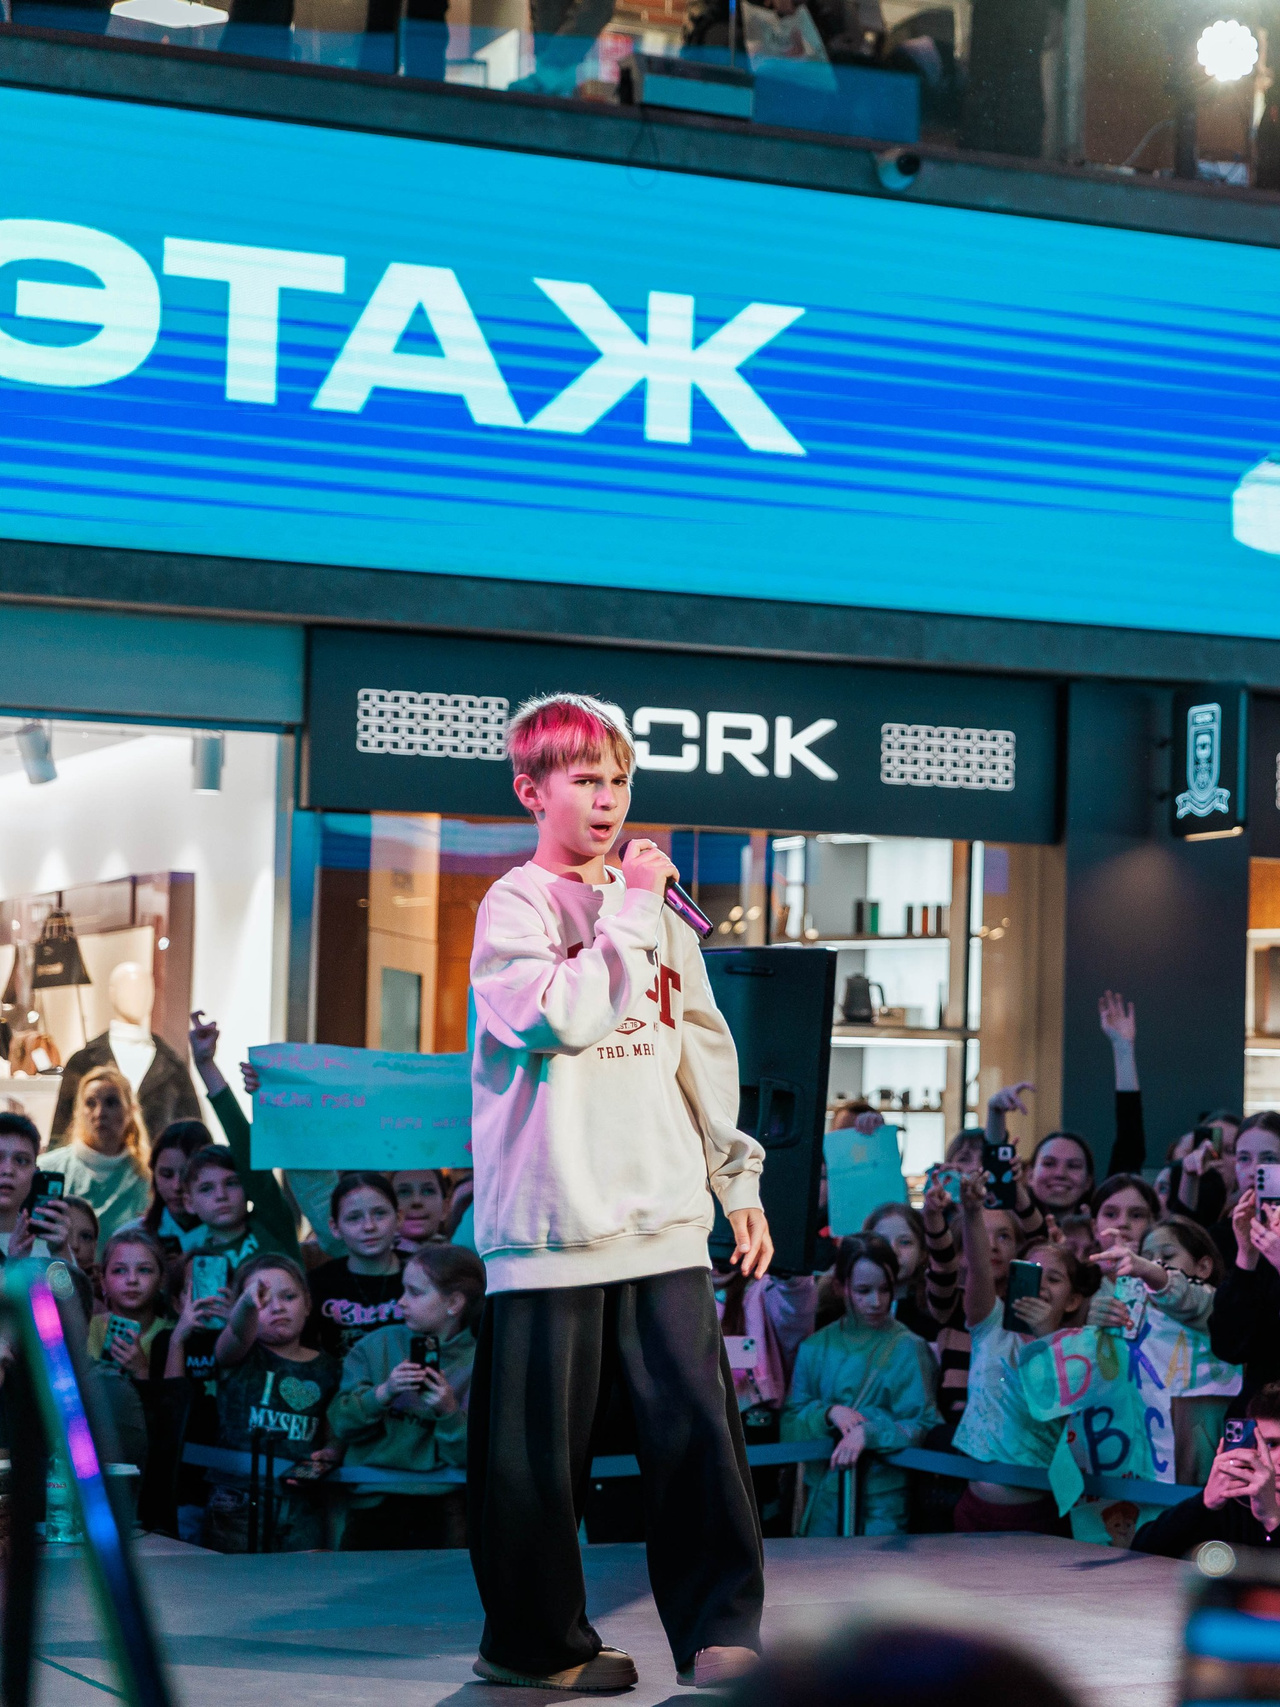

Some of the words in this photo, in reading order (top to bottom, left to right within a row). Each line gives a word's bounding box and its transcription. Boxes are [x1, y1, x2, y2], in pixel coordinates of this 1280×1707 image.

[0, 218, 807, 457] ЭТАЖ
[599, 704, 839, 781] ORK
[596, 1045, 630, 1060] TRD.
[260, 1371, 275, 1405] I
